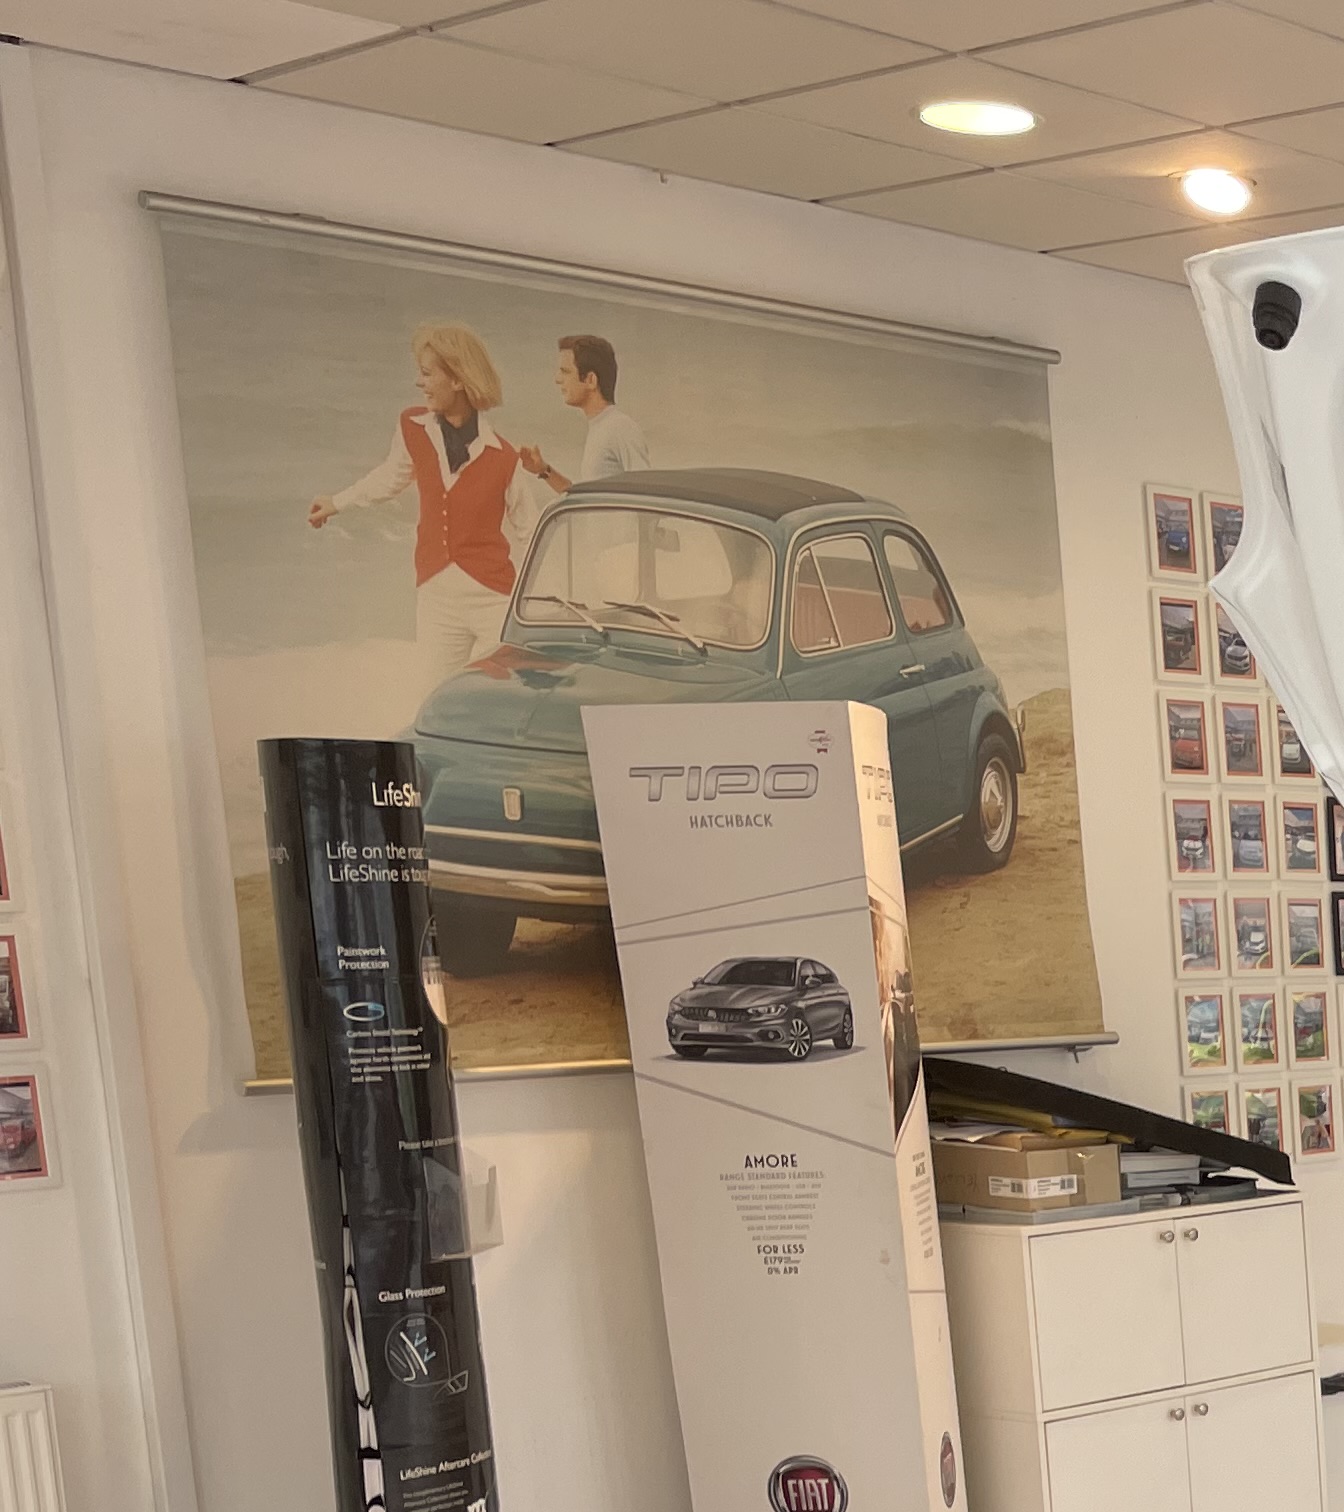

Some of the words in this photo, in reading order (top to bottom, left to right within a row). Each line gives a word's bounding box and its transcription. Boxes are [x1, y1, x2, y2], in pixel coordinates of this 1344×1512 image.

[629, 764, 819, 802] TIPO
[689, 813, 773, 829] HATCHBACK
[325, 842, 357, 860] Life
[361, 846, 383, 860] on
[385, 842, 407, 860] the
[328, 864, 399, 883] LifeShine
[401, 865, 410, 882] is
[338, 959, 389, 971] Protection
[744, 1154, 798, 1168] AMORE
[757, 1244, 779, 1254] FOR
[782, 1243, 805, 1254] LESS
[783, 1266, 799, 1275] APR
[378, 1291, 403, 1303] Glass
[787, 1478, 830, 1512] FIAT
